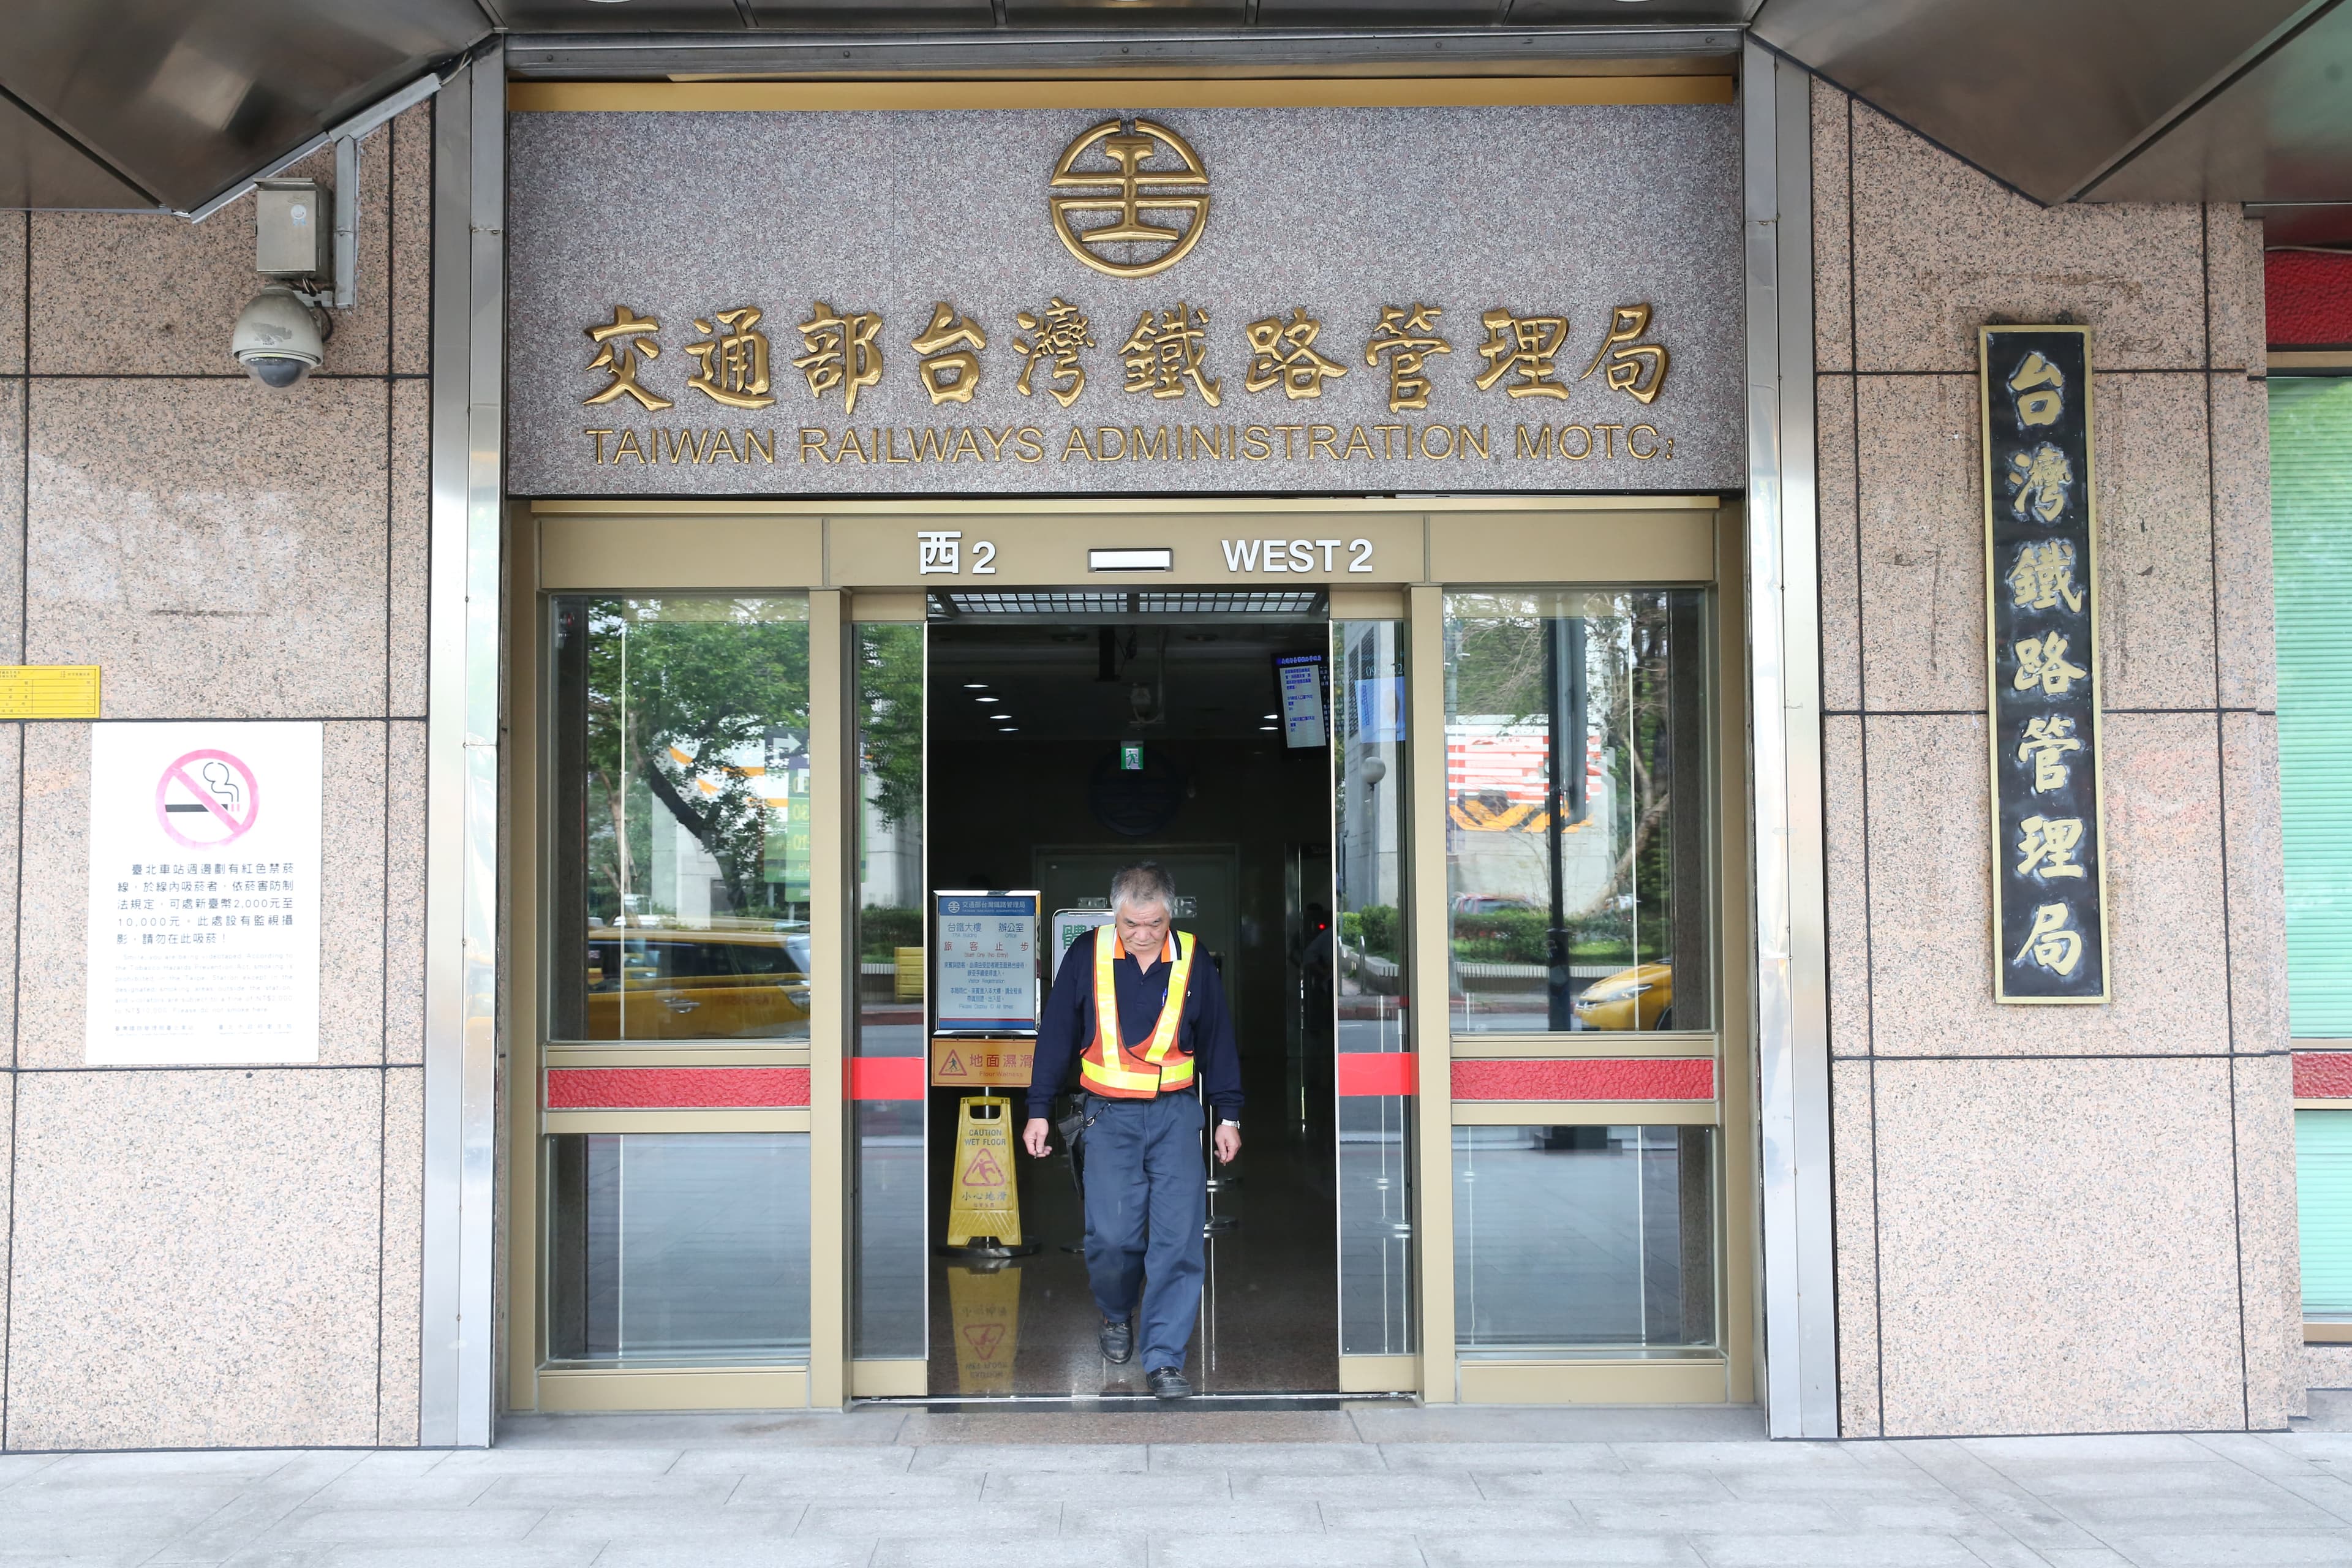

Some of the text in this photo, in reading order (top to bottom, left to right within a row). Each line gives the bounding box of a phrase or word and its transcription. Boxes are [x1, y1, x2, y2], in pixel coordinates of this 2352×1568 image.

[583, 297, 1672, 414] 交通部台灣鐵路管理局
[585, 428, 775, 464] TAIWAN
[799, 426, 1044, 464] RAILWAYS
[1061, 424, 1490, 463] ADMINISTRATION
[918, 531, 996, 575] 西 2
[1221, 539, 1373, 573] WEST 2
[2007, 353, 2086, 980] 台灣鐵路管理局
[998, 922, 1024, 932] 辦公室
[962, 1191, 1007, 1202] 小心地滑
